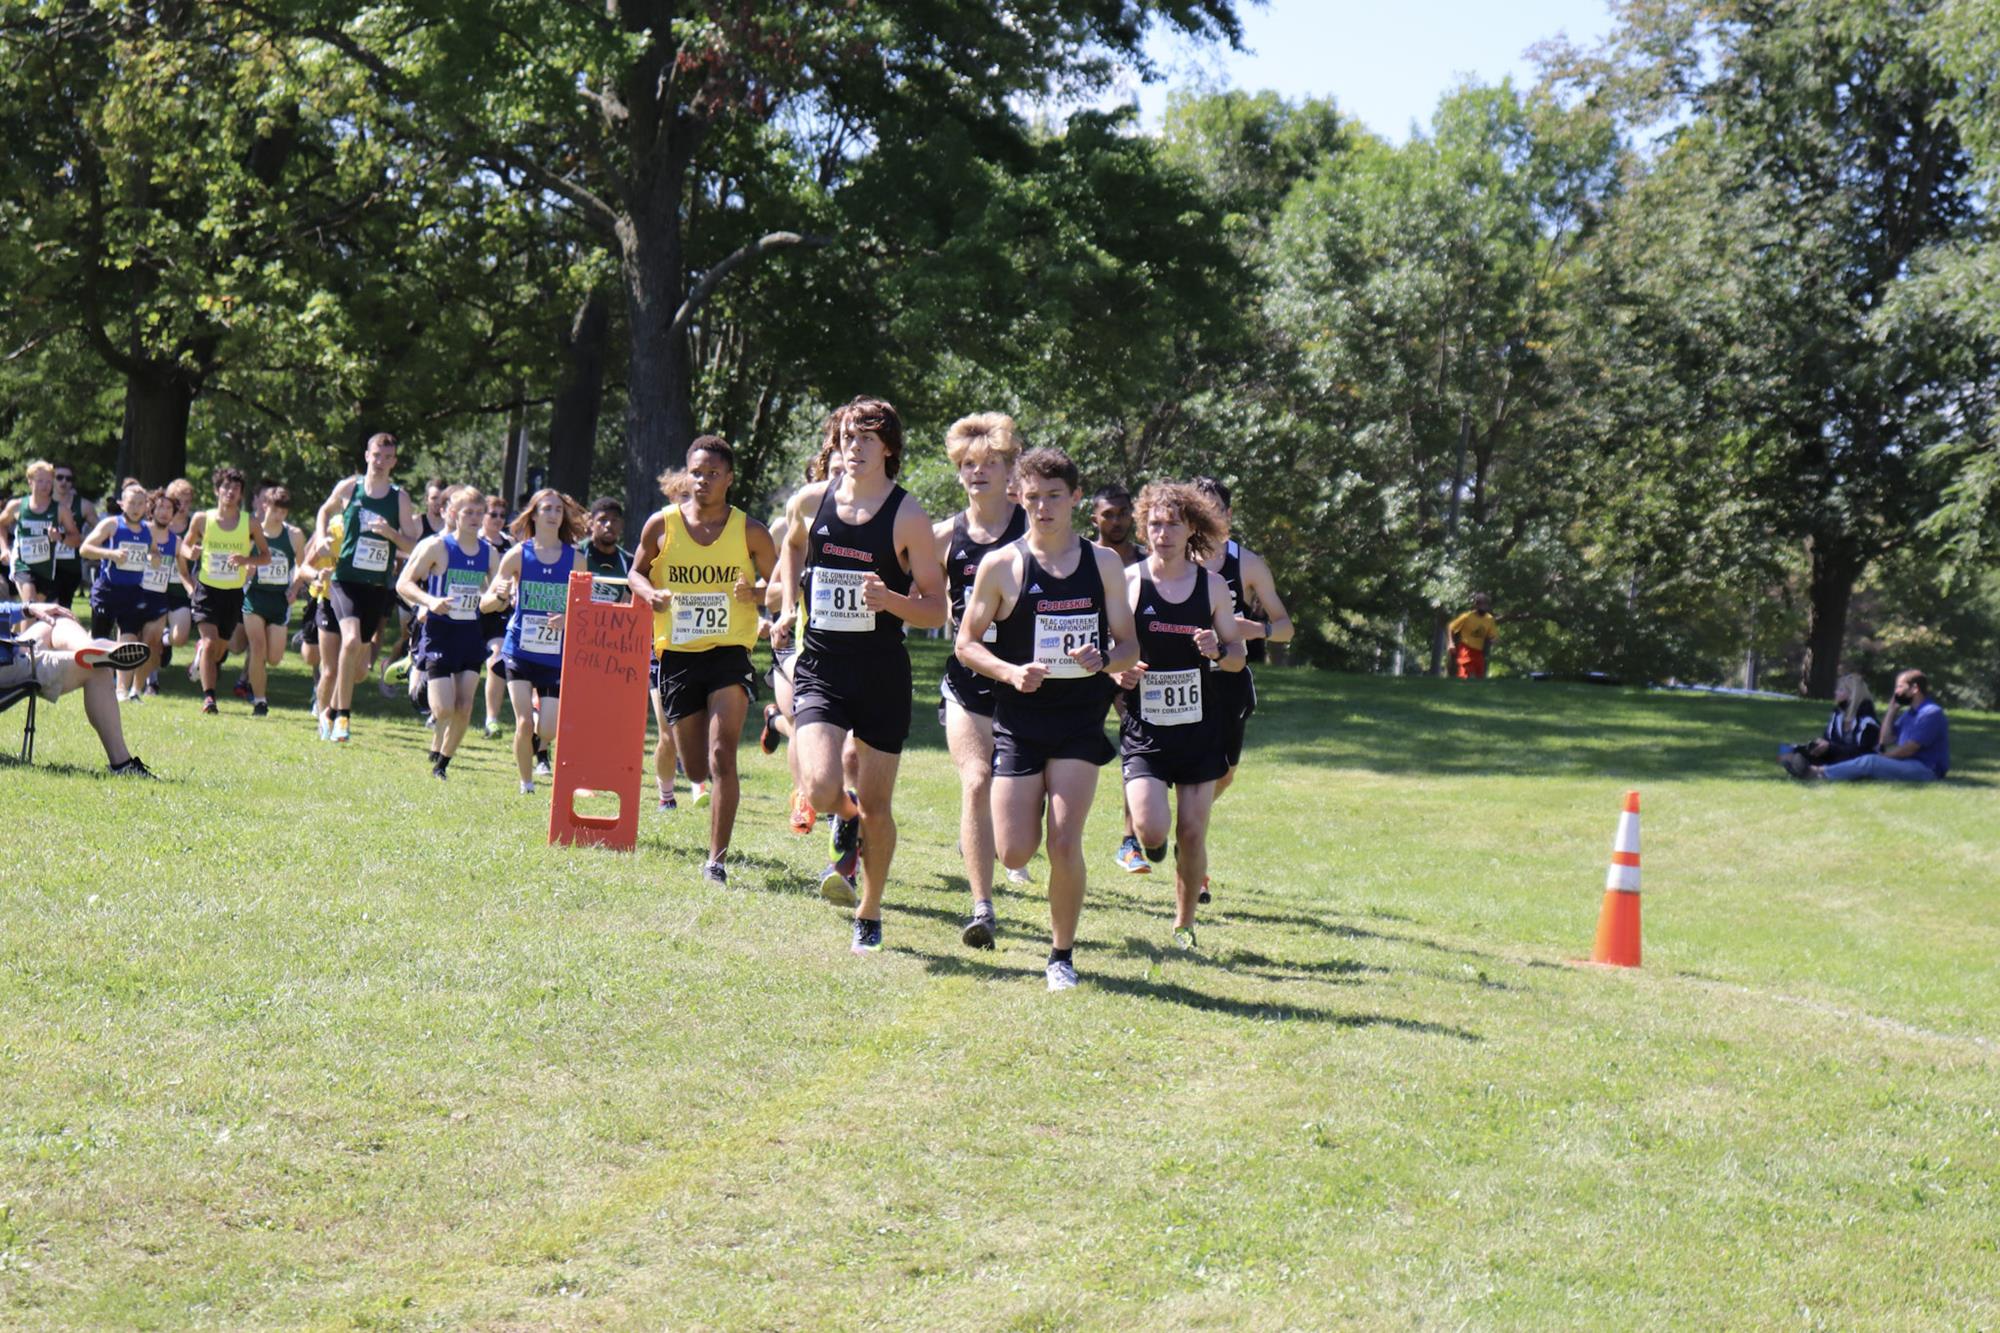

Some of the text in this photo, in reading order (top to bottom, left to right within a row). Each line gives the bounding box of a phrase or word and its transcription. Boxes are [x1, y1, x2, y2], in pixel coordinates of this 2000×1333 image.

[368, 547, 388, 561] 762
[269, 565, 287, 576] 763
[668, 564, 741, 584] BROOME
[830, 572, 865, 580] CONFEREN
[817, 578, 865, 586] CHAMPIONSHIP
[834, 587, 866, 611] 81
[1036, 597, 1093, 613] COBLESKILL
[694, 607, 728, 628] 792
[814, 609, 870, 619] SUNY COBLESKILL
[576, 609, 639, 640] SUNY
[1039, 617, 1058, 625] NEAC
[537, 625, 560, 642] 721
[1038, 657, 1057, 665] SUNY
[1143, 671, 1197, 681] NEAC CONFERENCE
[1146, 678, 1194, 686] CHAMPIONSHIPS
[1164, 684, 1199, 707] 816
[1162, 706, 1198, 714] COBLESKILL
